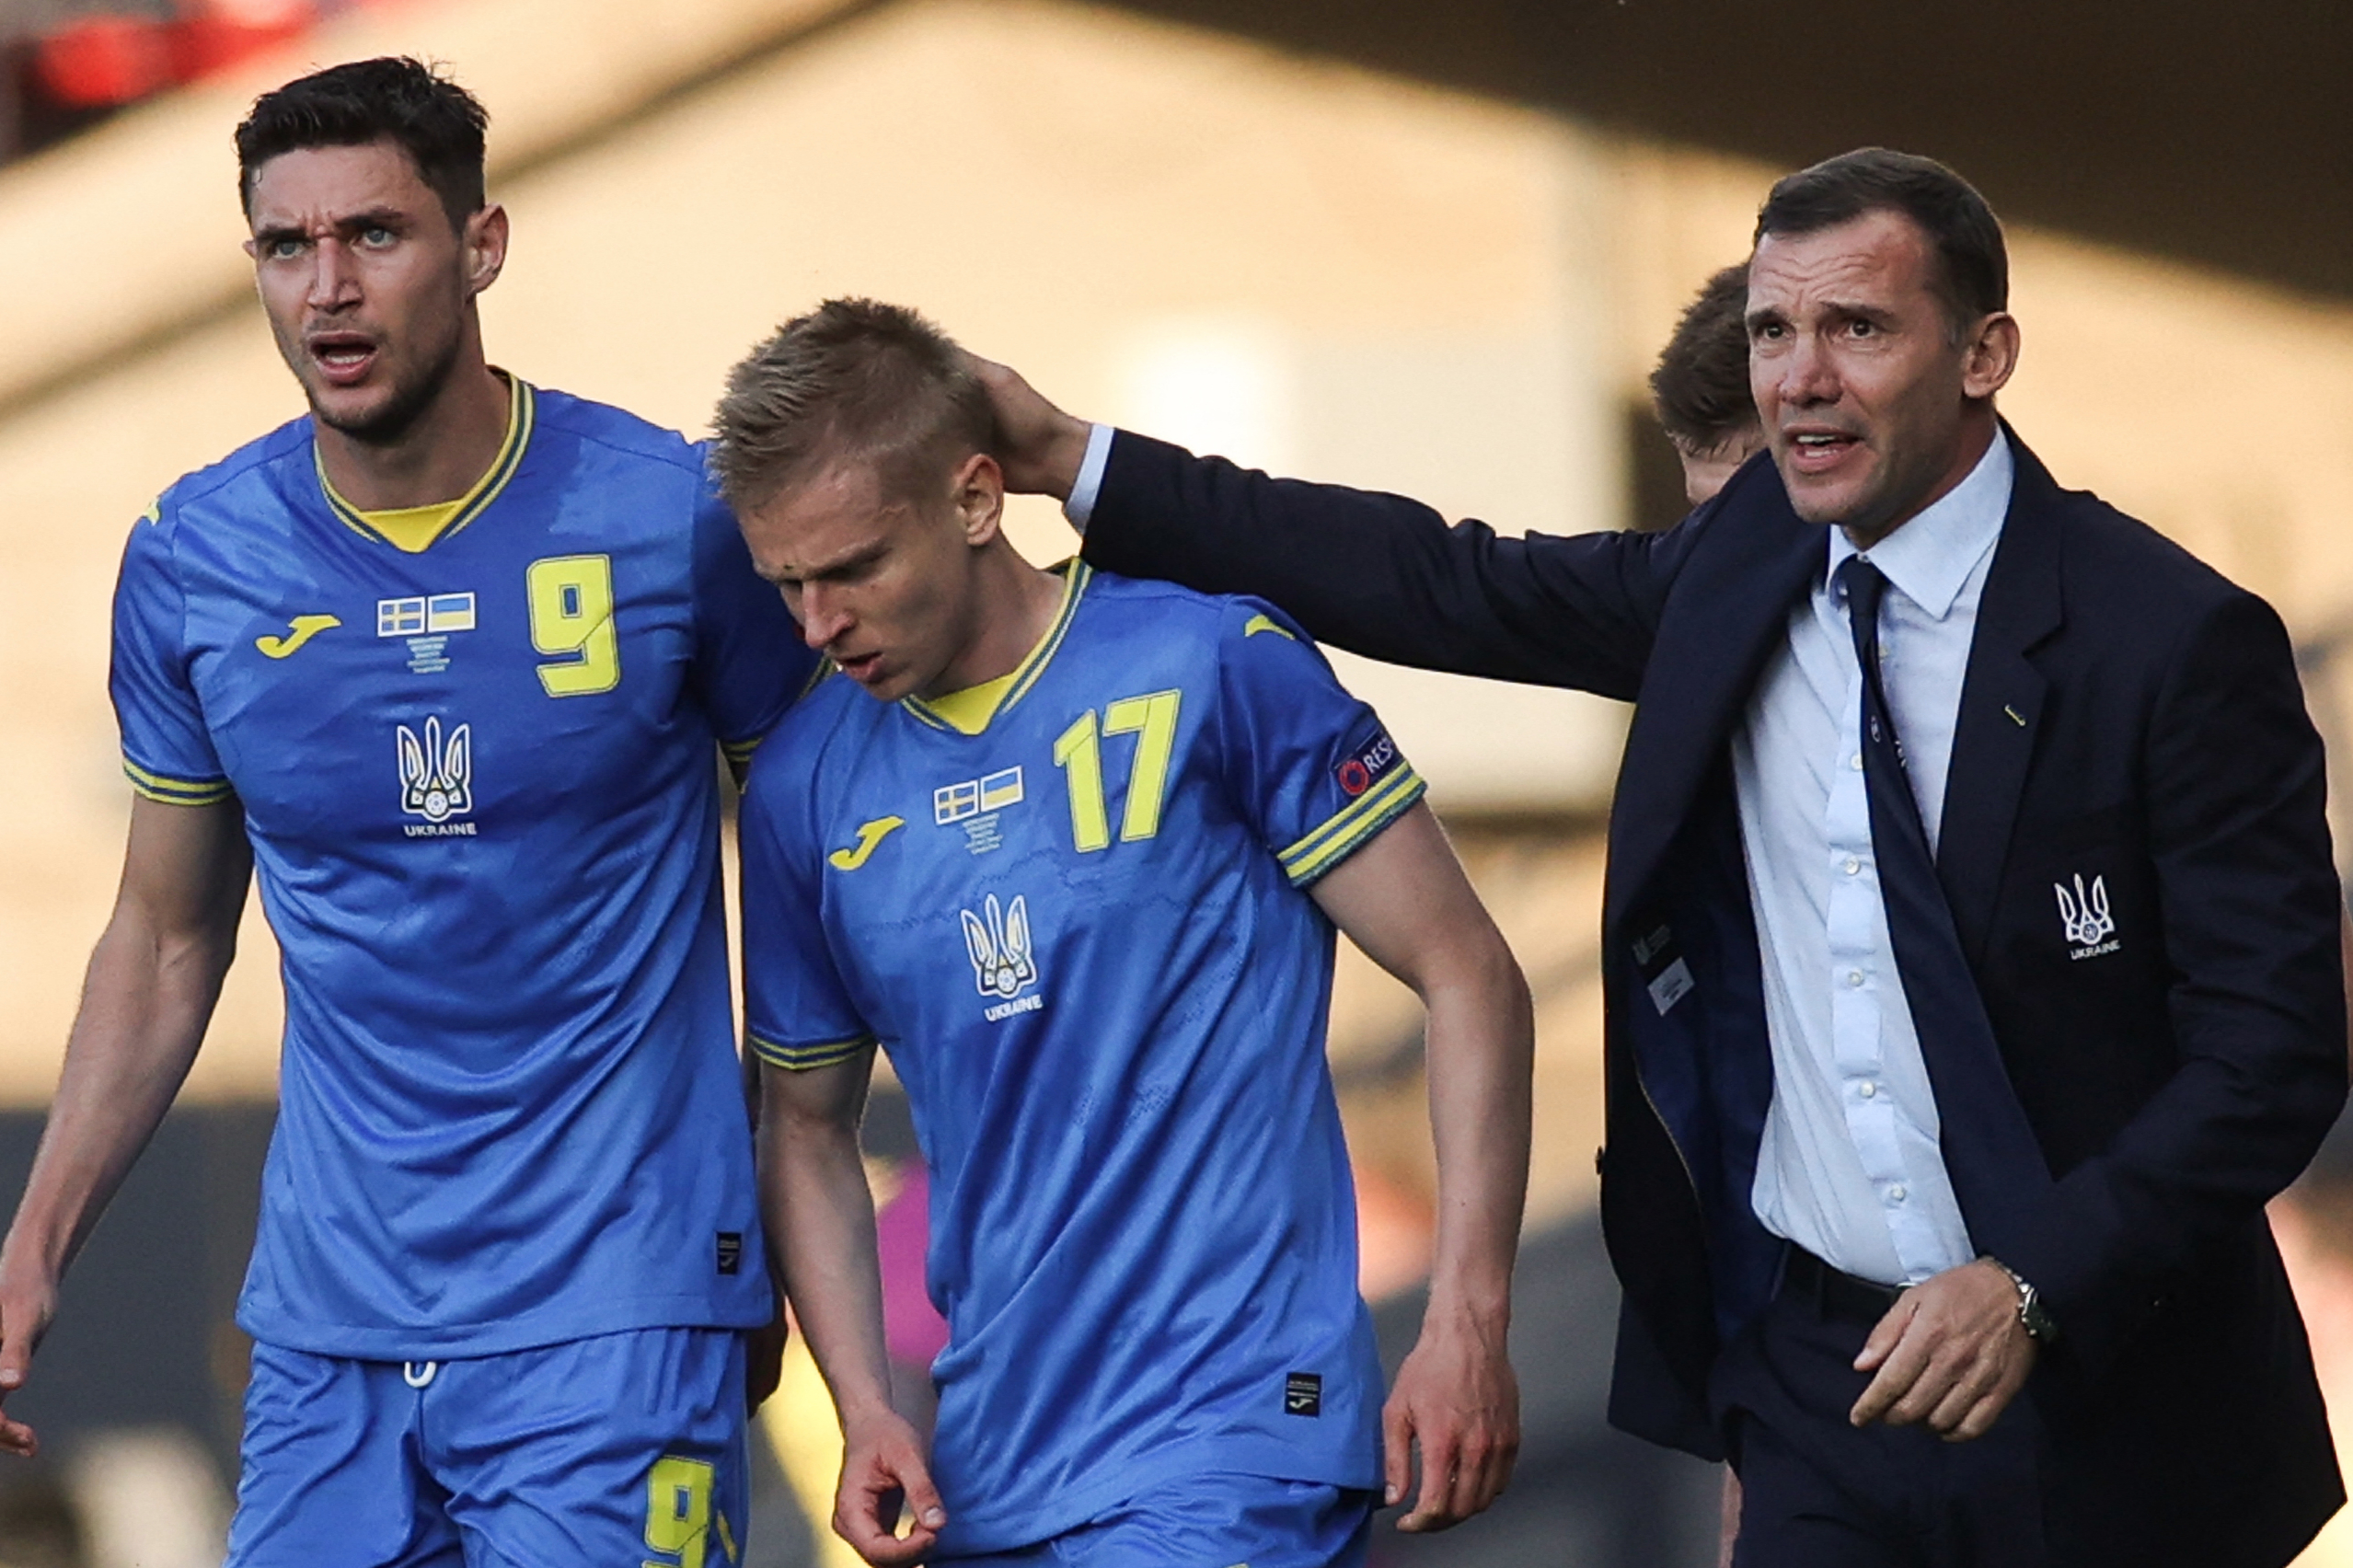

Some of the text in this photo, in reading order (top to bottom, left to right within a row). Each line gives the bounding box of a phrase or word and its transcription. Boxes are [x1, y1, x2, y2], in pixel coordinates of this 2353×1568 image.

[525, 554, 620, 698] 9
[1054, 688, 1182, 853] 17
[404, 822, 477, 836] UKRAINE
[2070, 939, 2120, 960] UKRAINE
[984, 994, 1044, 1021] UKRAINE
[641, 1455, 714, 1568] 9
